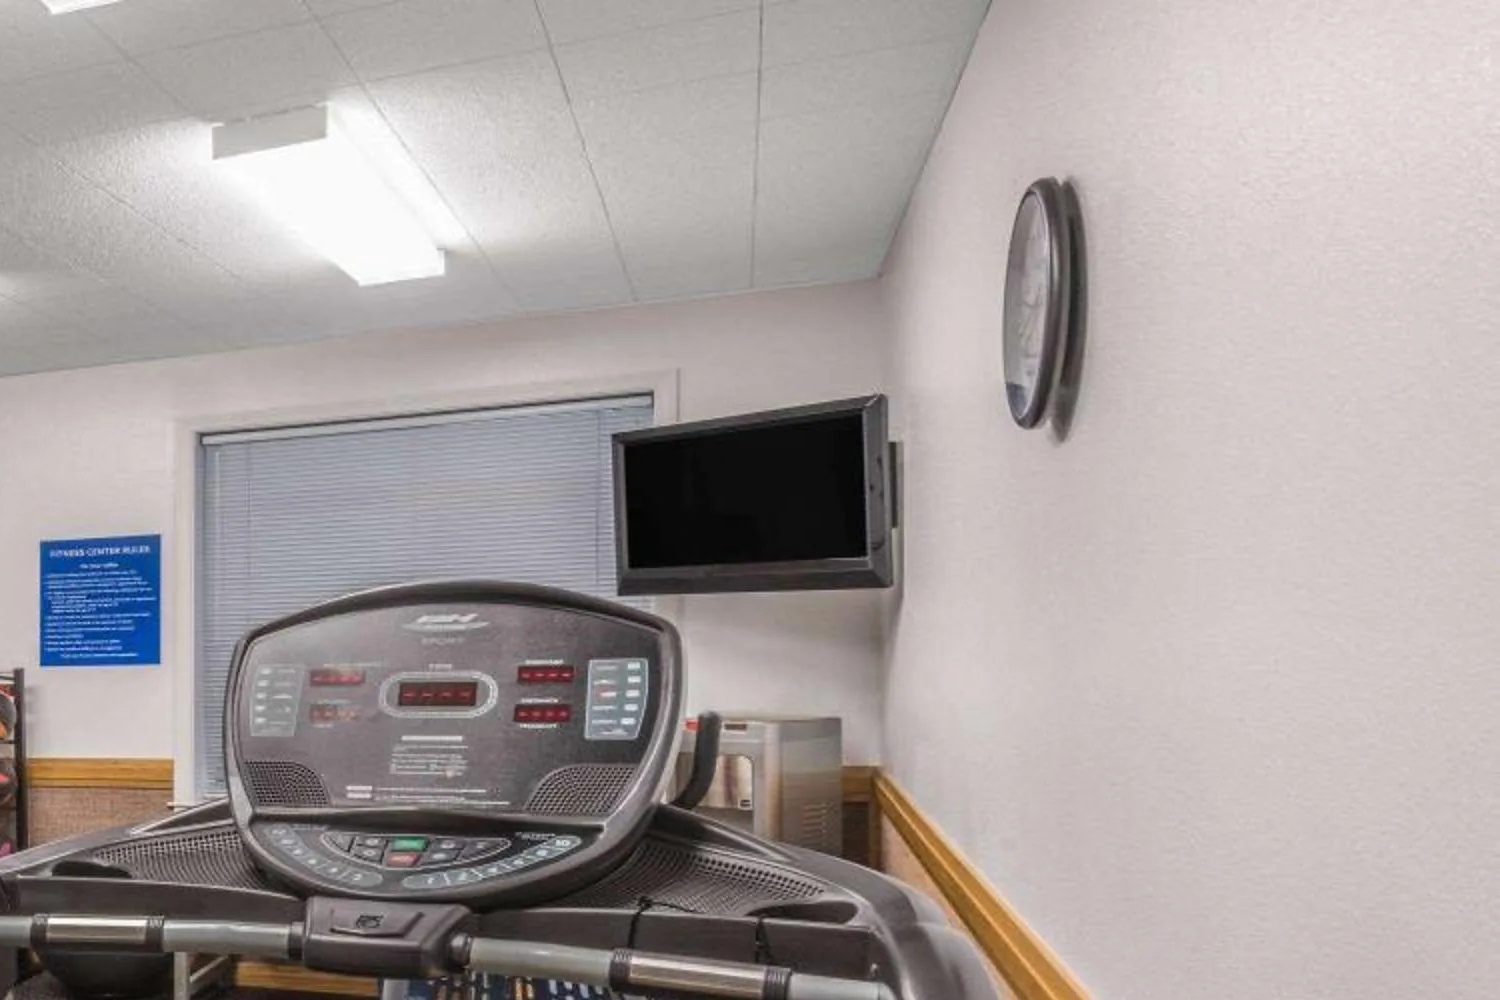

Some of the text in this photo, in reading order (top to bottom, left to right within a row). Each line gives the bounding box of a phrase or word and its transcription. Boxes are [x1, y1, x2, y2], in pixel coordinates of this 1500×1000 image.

[50, 545, 151, 558] FITNESS CENTER RULES
